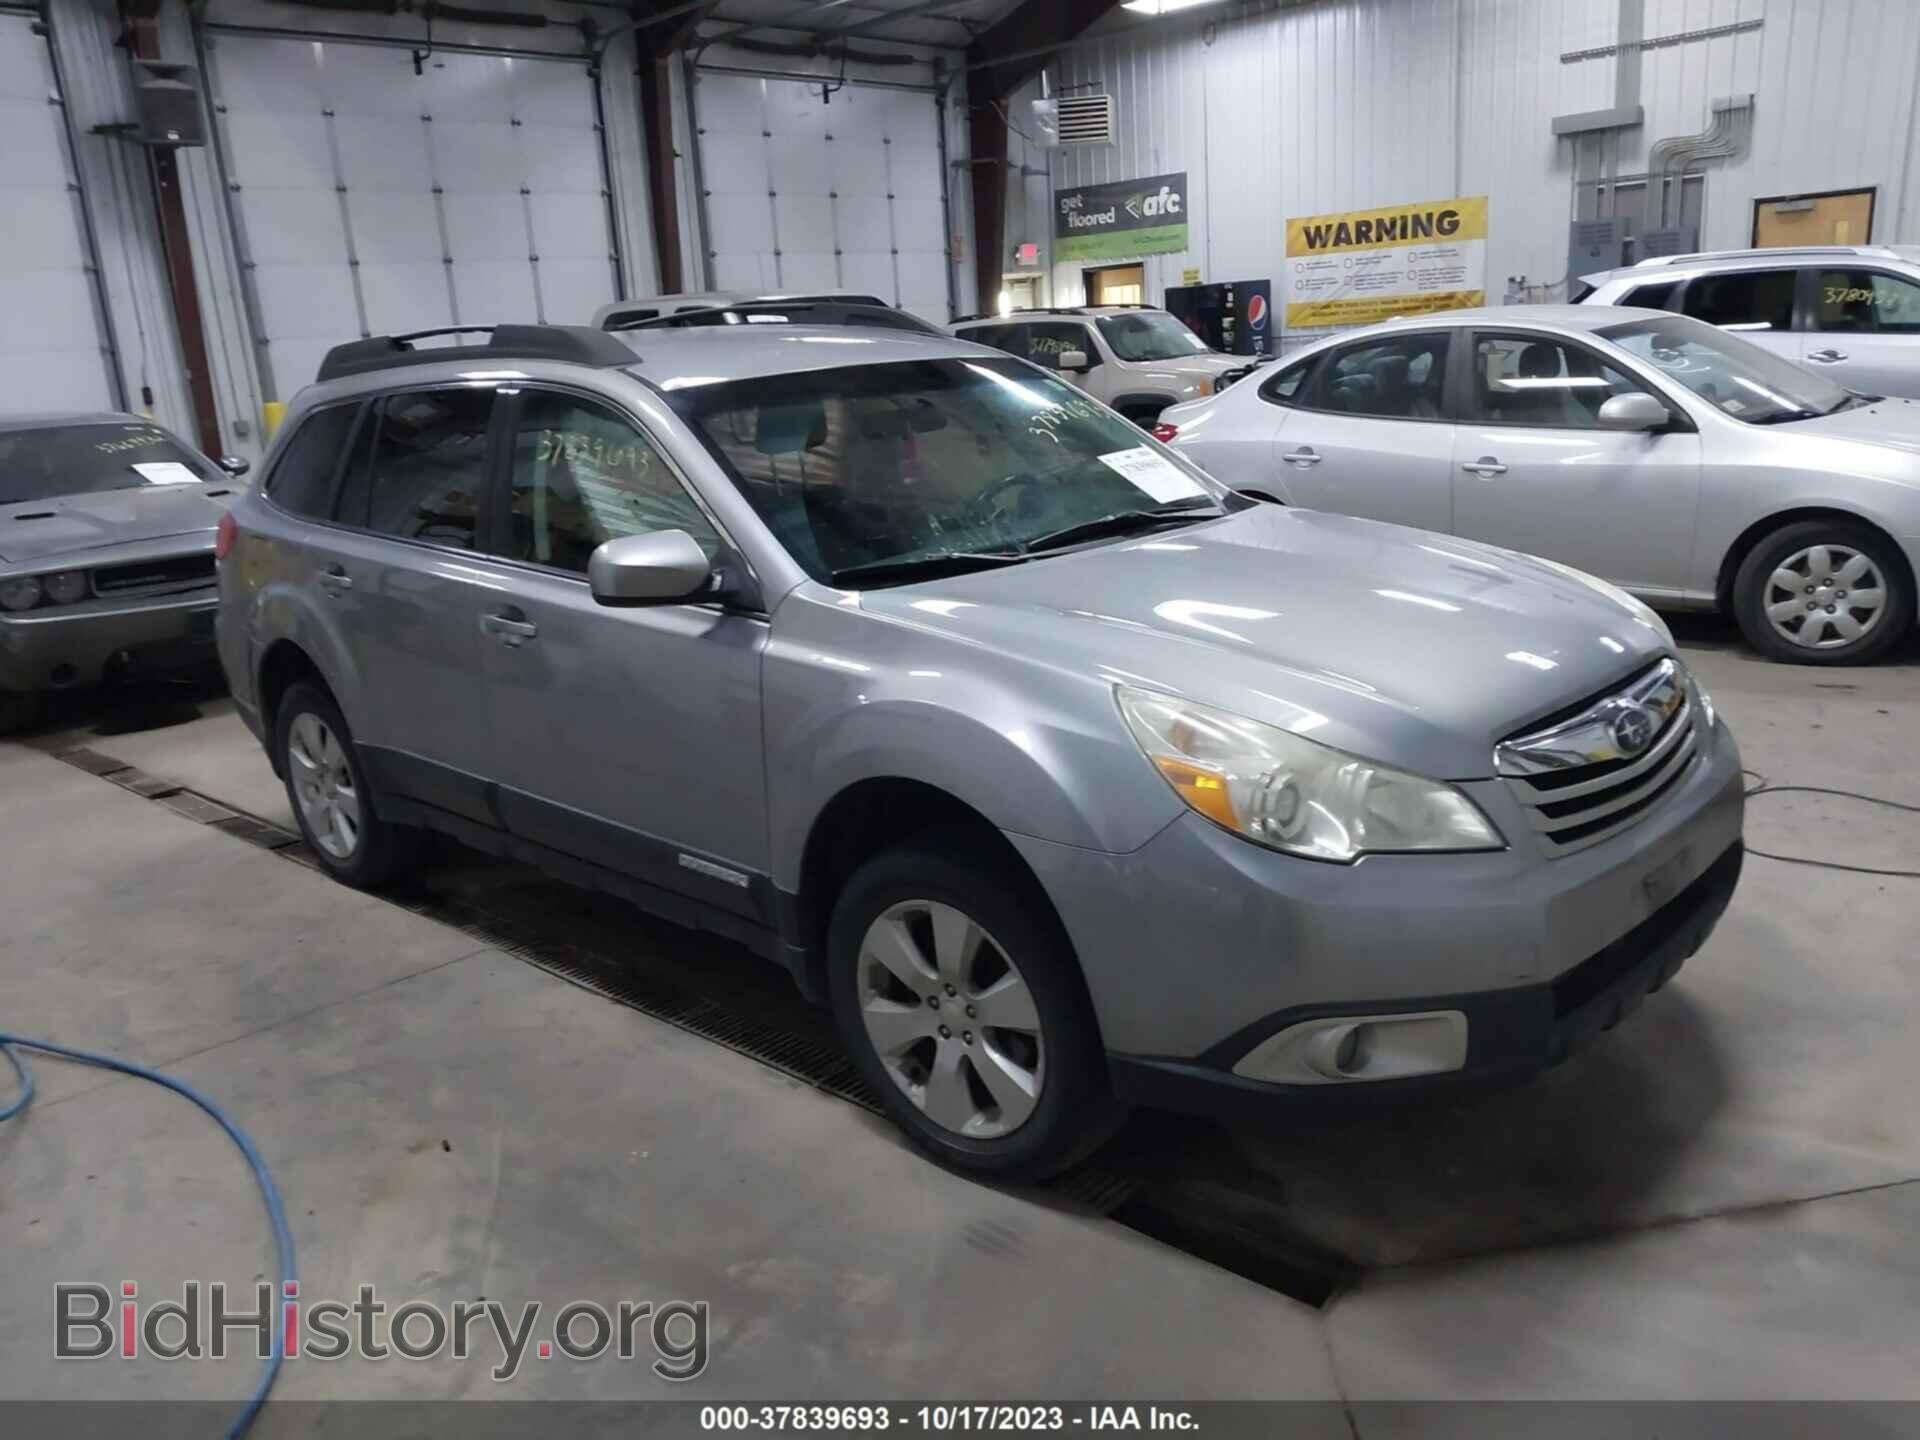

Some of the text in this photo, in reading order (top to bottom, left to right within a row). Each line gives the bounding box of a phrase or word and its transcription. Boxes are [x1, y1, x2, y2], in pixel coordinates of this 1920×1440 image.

[1060, 193, 1084, 214] get
[1142, 185, 1181, 217] afc
[1067, 206, 1116, 229] floored
[1302, 209, 1461, 250] WARNING
